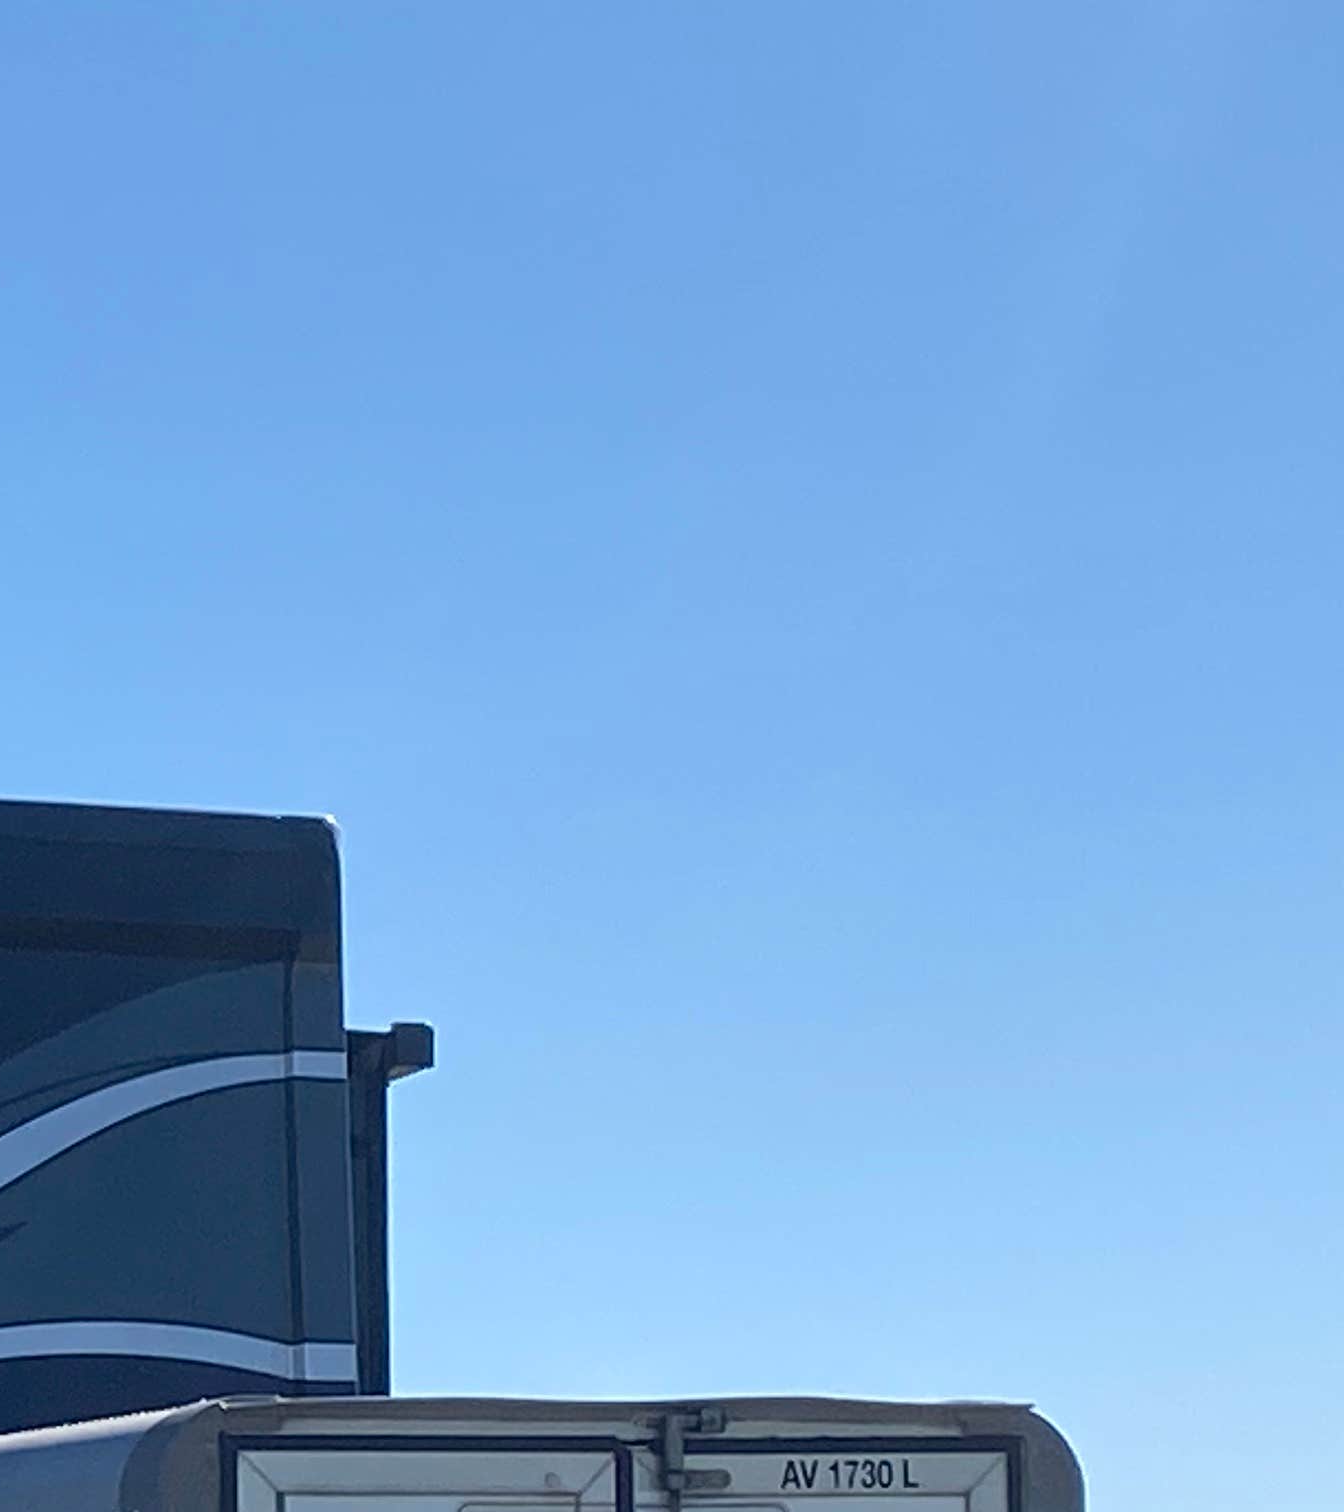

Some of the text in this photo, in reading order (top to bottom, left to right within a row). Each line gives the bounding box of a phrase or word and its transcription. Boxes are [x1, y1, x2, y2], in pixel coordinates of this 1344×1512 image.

[780, 1458, 920, 1490] AV 1730 L
